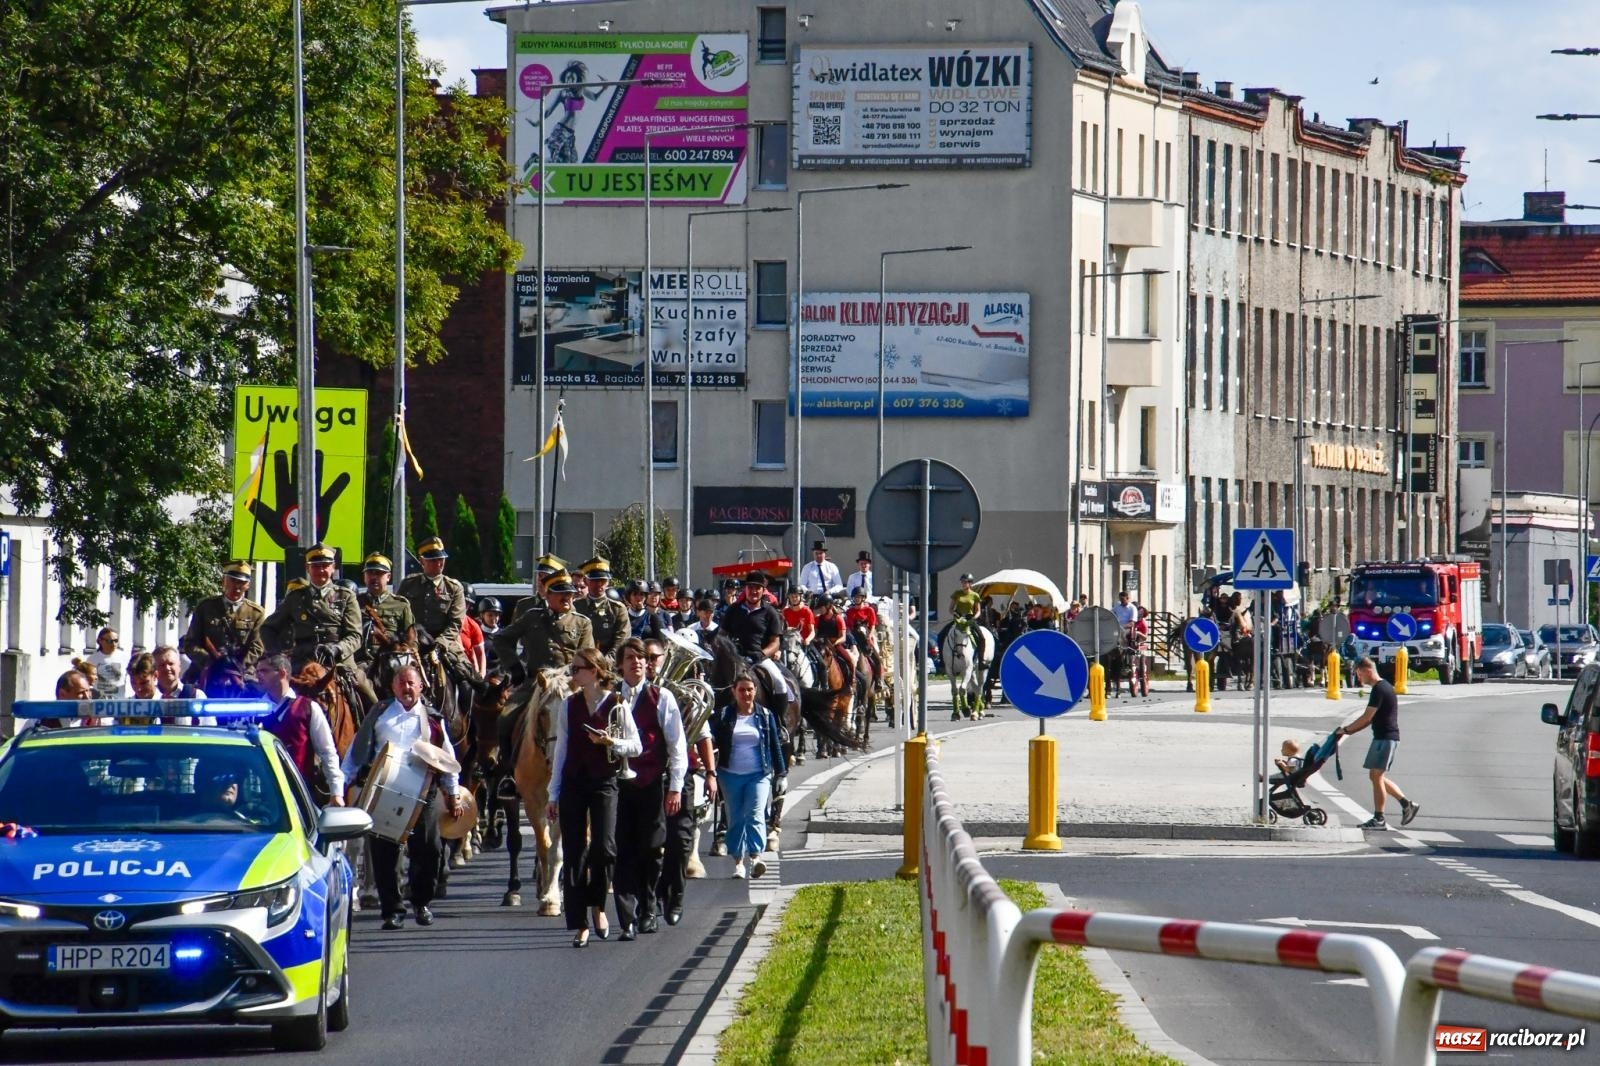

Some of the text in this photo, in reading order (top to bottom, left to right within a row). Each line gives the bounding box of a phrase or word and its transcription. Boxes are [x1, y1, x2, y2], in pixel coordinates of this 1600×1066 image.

[834, 62, 922, 82] widlatex
[928, 50, 1021, 88] WÓZKI
[930, 101, 1020, 113] DO 32 TON
[940, 117, 995, 126] sprzedaż
[940, 128, 994, 138] wynajem
[939, 140, 980, 148] serwis
[664, 150, 687, 160] 600
[689, 150, 710, 160] 247
[712, 150, 734, 160] 894
[566, 168, 713, 192] TU JESTEŚMY
[516, 274, 538, 285] Blaty
[548, 274, 590, 283] kamienia
[521, 284, 558, 293] spieów
[655, 306, 737, 319] Kuchnie
[840, 302, 969, 326] KLIMATYZACJI
[984, 303, 1023, 318] ALASKA
[801, 344, 842, 353] SPRZEDAŻ
[801, 355, 836, 363] MONTAŻ
[584, 375, 599, 384] 52,
[605, 374, 645, 382] Racibór
[656, 375, 671, 383] tel.
[696, 376, 714, 384] 332
[801, 376, 864, 384] CHŁODNICTWO
[893, 399, 914, 408] 607
[919, 399, 939, 408] 376
[943, 399, 964, 408] 336
[246, 396, 356, 432] Uwga
[709, 506, 844, 521] RACIBORSKI ARBER
[95, 702, 164, 716] POLICJA
[33, 860, 192, 880] POLICJA
[61, 946, 166, 968] HPP R204
